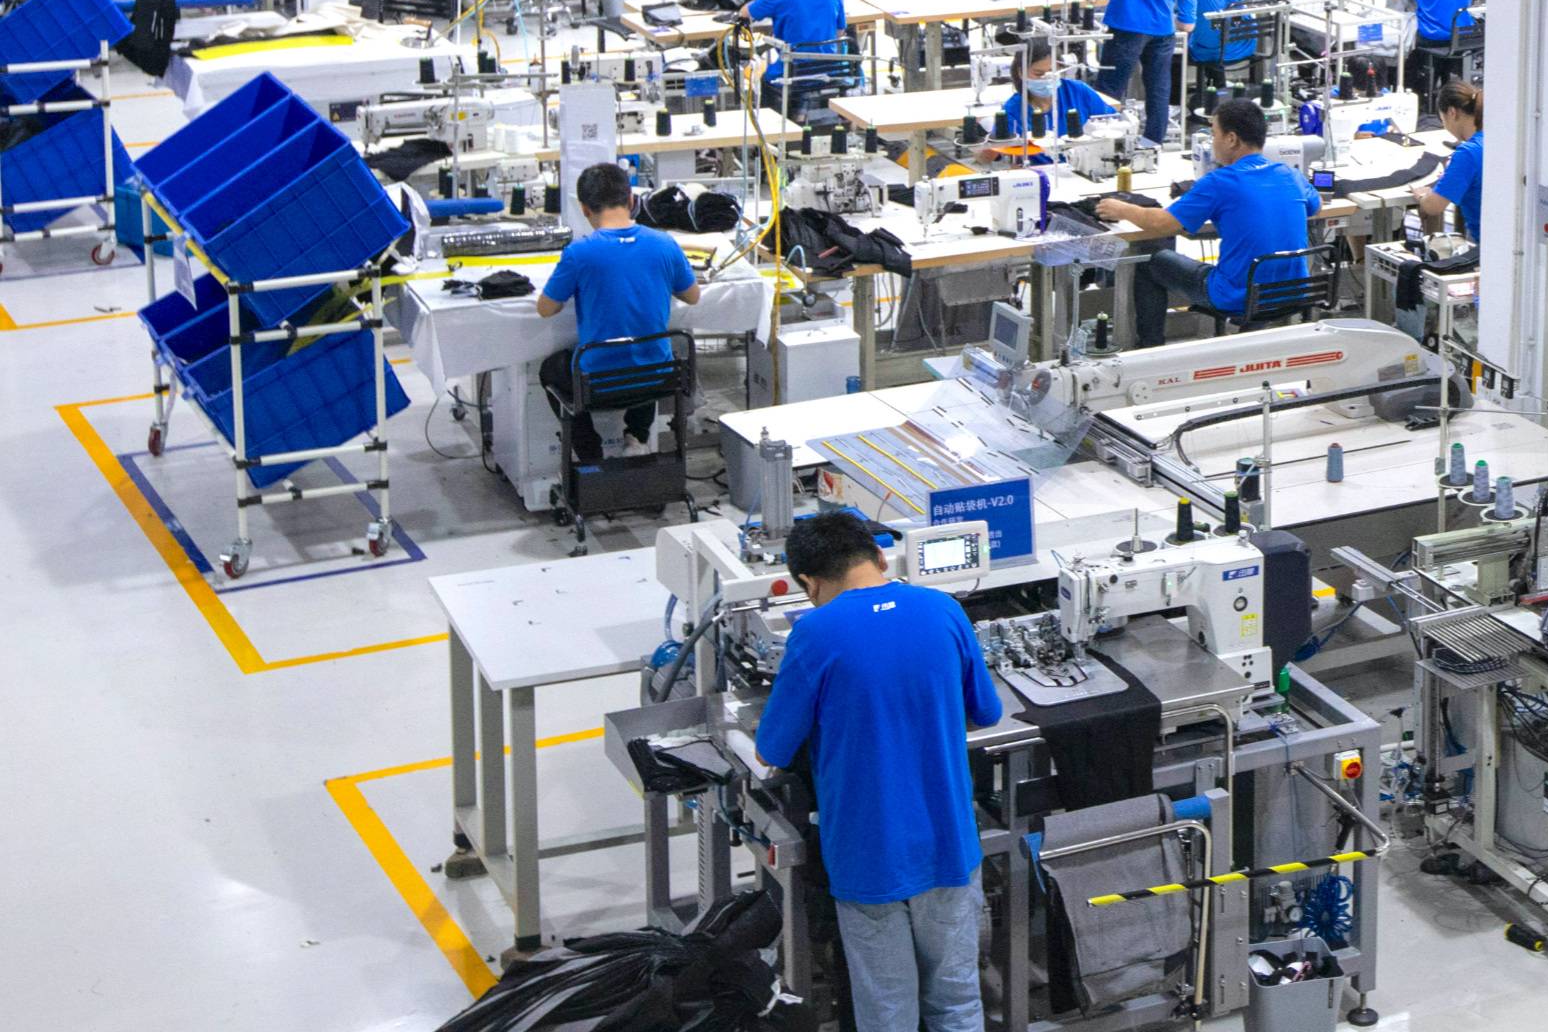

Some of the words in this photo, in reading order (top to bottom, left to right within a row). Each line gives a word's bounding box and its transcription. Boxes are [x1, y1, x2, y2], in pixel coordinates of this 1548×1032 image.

[933, 494, 1014, 517] 自动贴袋机-V2.0
